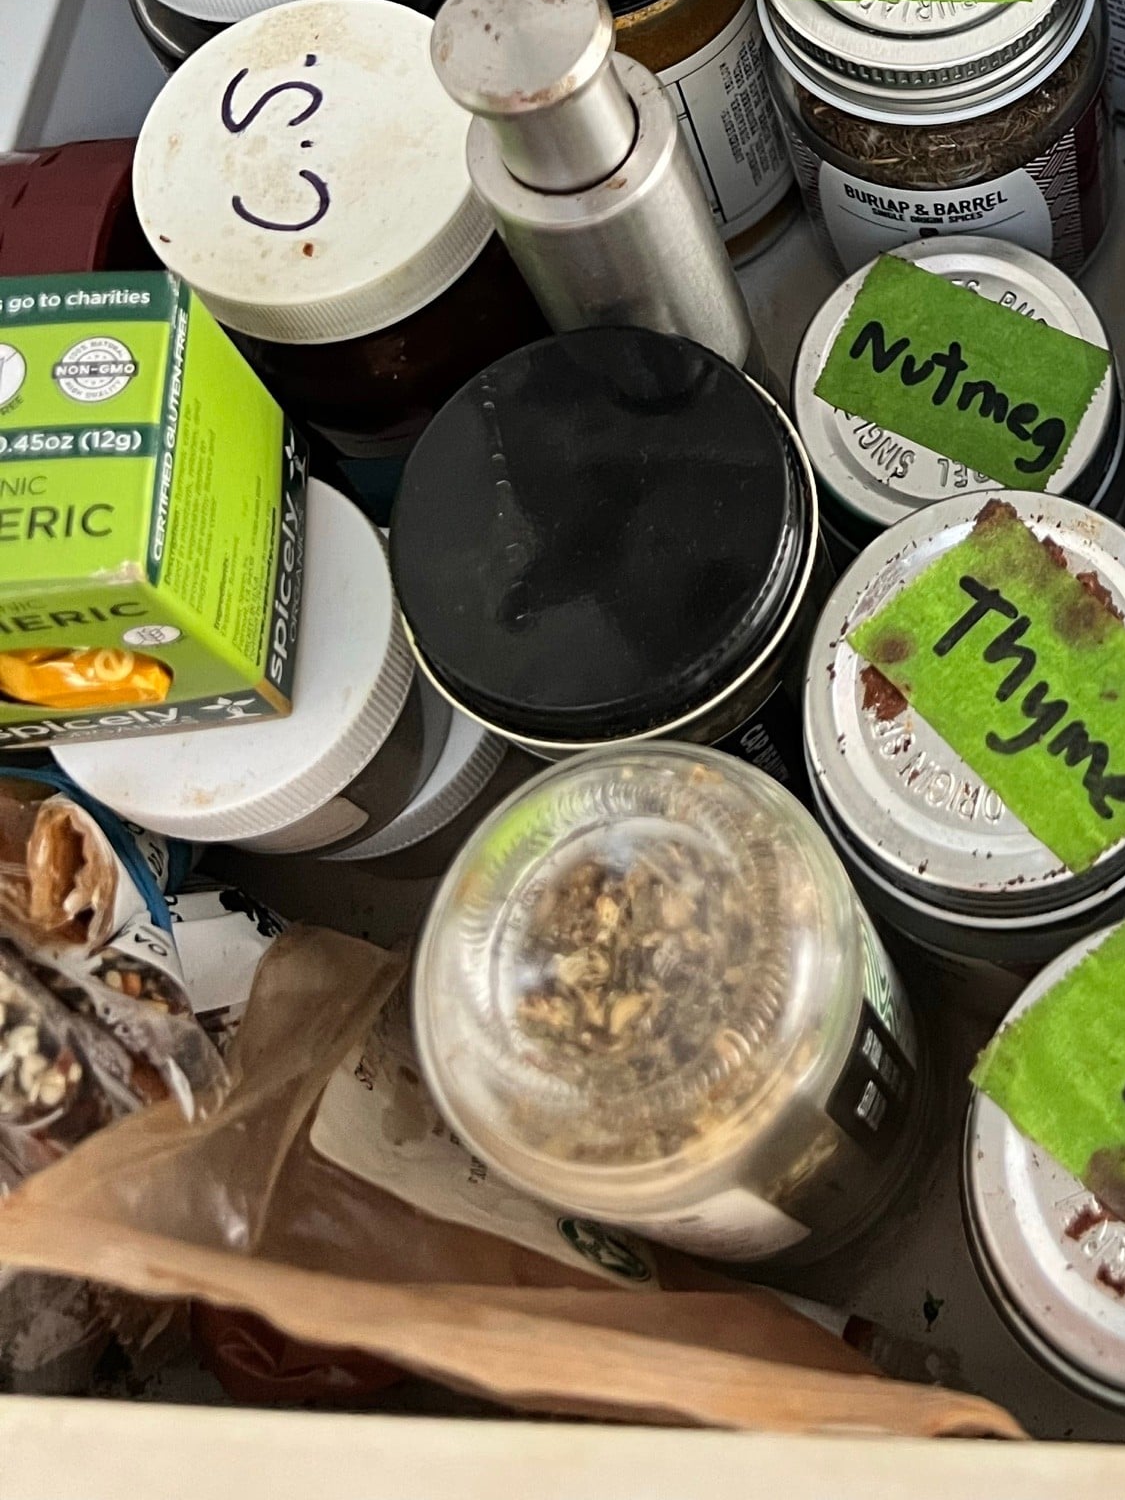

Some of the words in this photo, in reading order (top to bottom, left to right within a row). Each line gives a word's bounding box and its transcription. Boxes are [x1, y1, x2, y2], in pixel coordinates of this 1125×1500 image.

[843, 183, 910, 214] BURLAP
[915, 203, 929, 216] &
[934, 190, 1009, 216] BARREL
[9, 294, 35, 313] go
[40, 292, 61, 308] to
[65, 289, 151, 306] charities
[55, 363, 136, 376] NON-GMO
[849, 320, 1066, 474] Nutmeg
[82, 430, 142, 451] (12g)
[0, 503, 115, 541] ERIC
[152, 451, 174, 561] CERTIFIED
[270, 490, 303, 684] spicely
